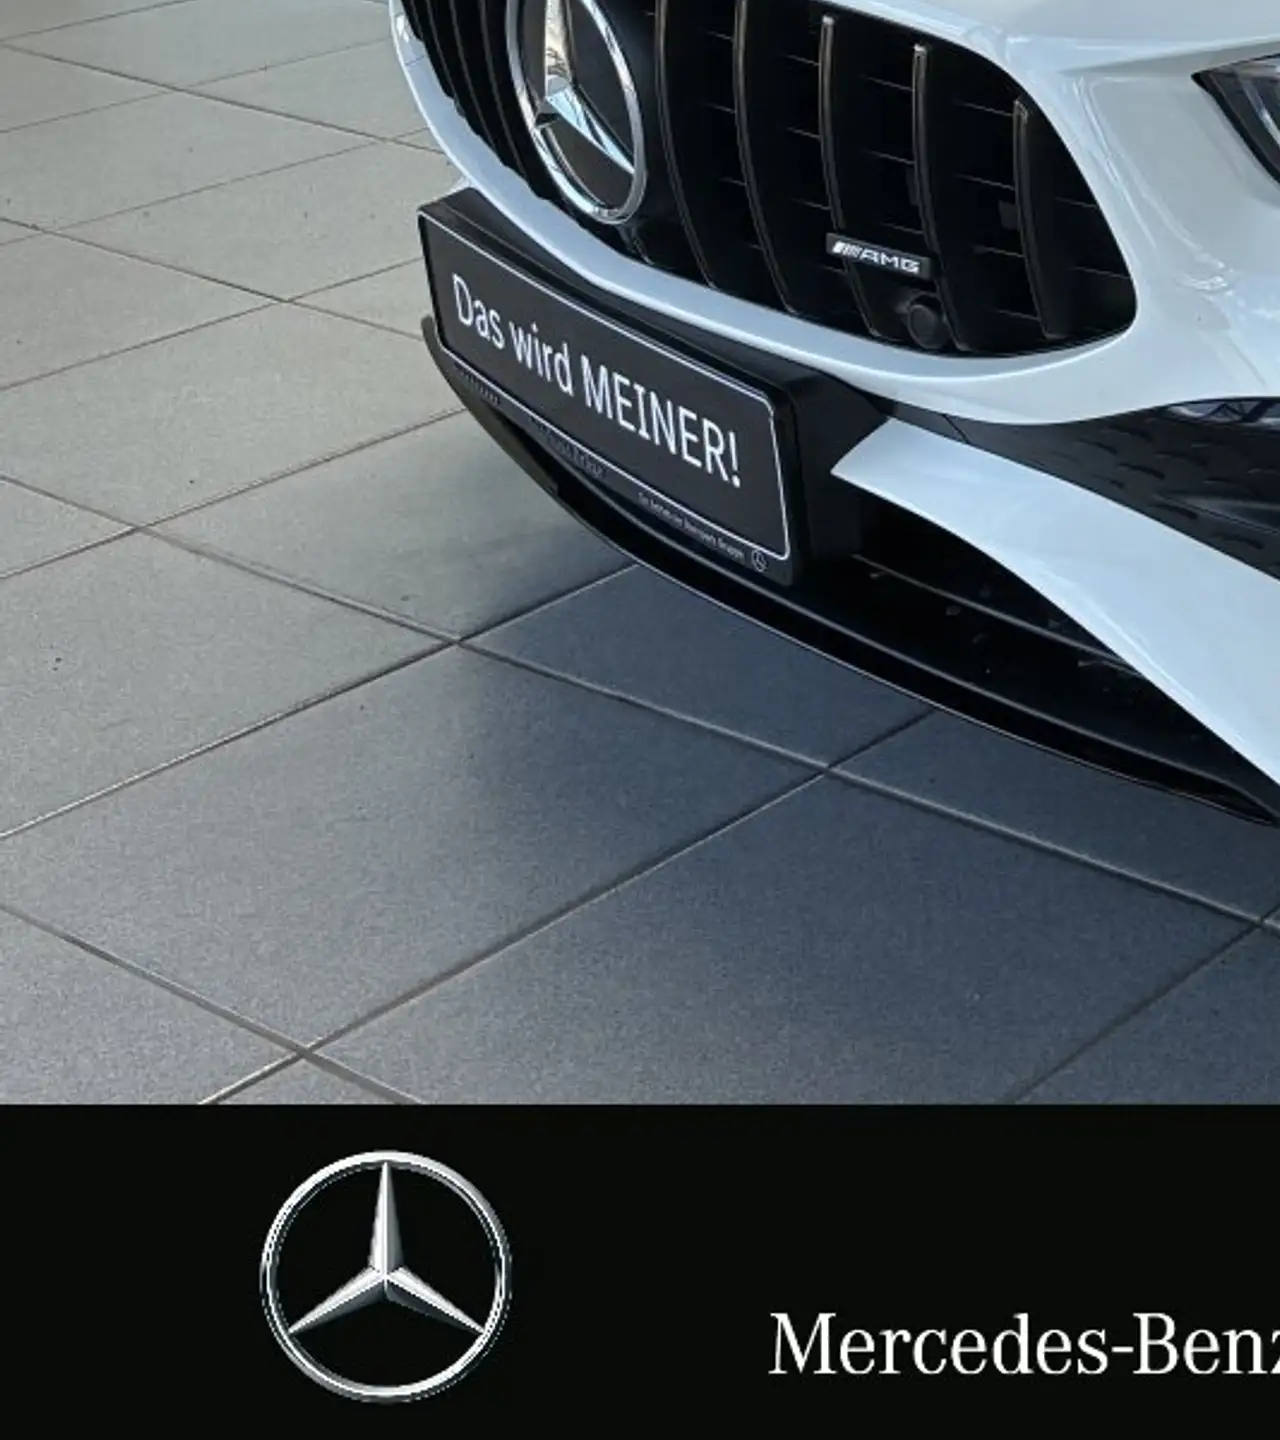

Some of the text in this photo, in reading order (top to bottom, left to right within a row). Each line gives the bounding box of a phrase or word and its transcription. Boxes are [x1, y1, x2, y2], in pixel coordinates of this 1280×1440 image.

[452, 273, 505, 350] Das
[509, 323, 575, 394] wird
[580, 354, 741, 488] MEINER!
